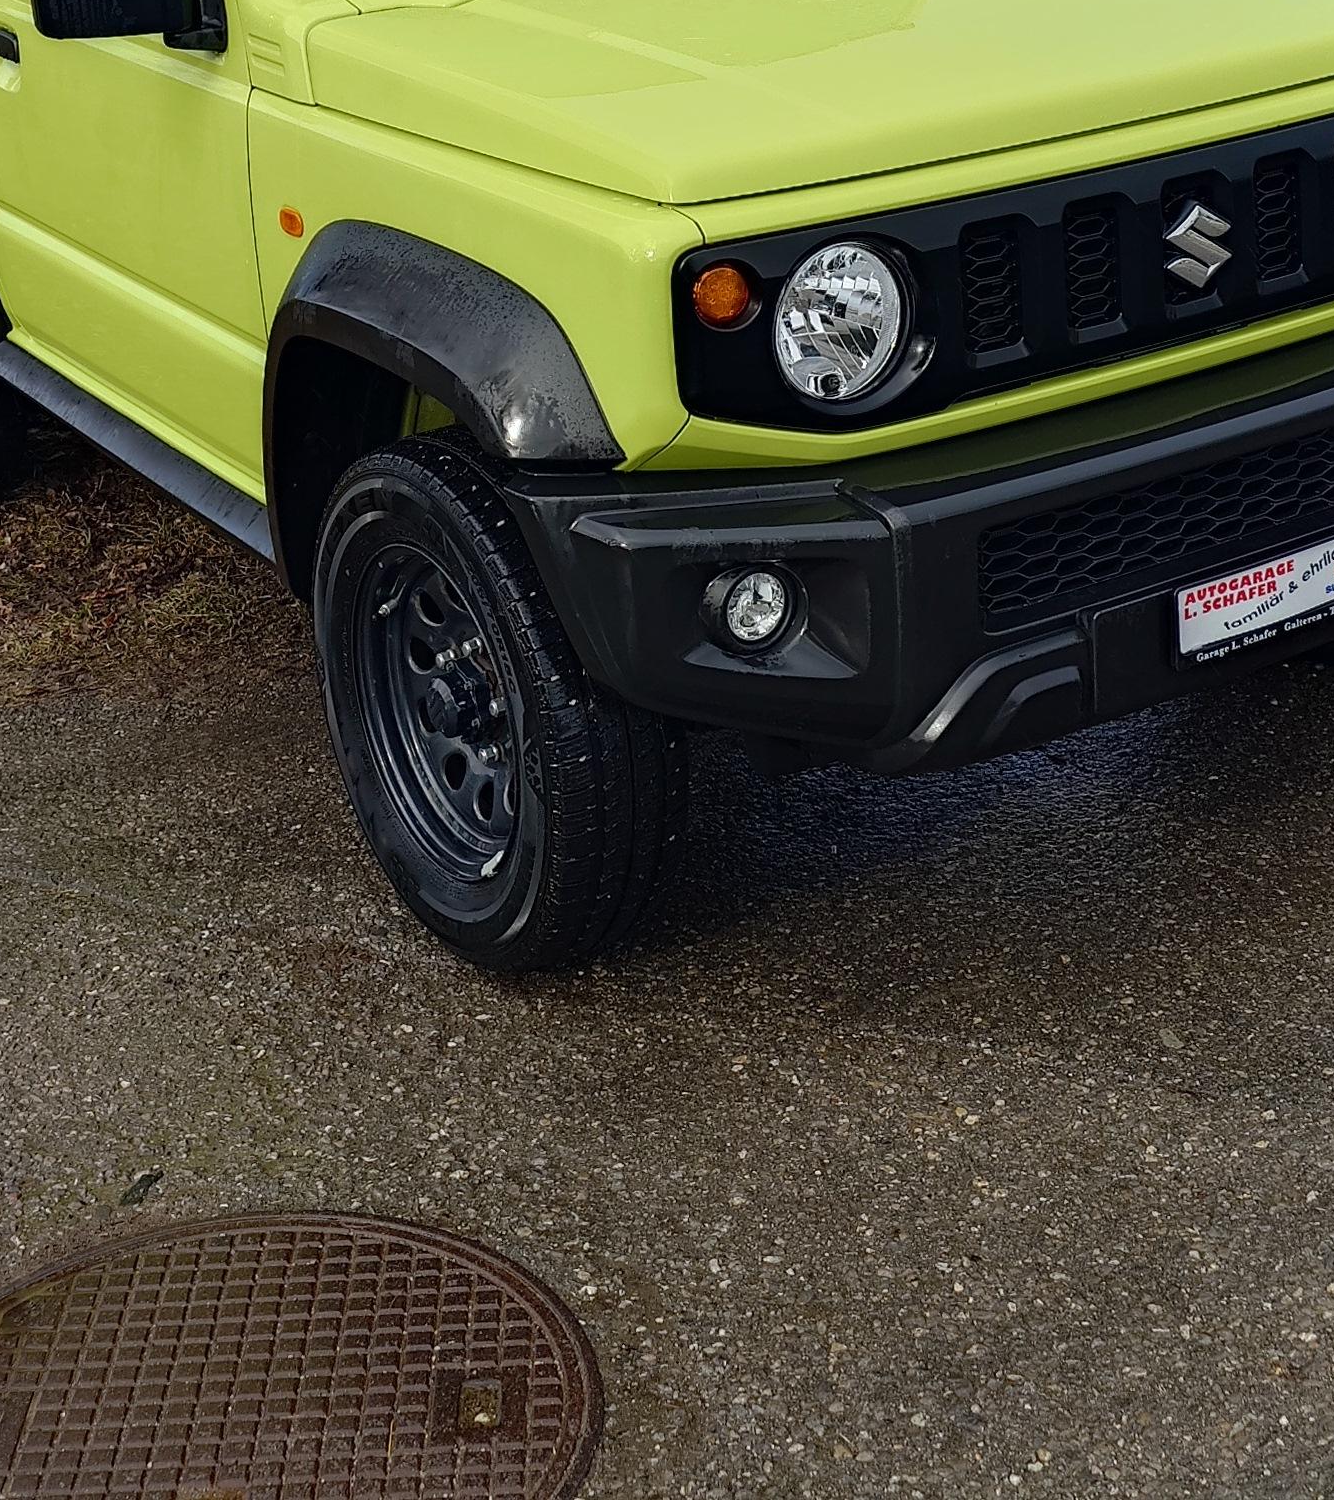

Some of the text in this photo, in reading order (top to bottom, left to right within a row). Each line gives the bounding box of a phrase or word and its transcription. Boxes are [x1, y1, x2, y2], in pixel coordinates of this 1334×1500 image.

[1183, 580, 1277, 620] L. SCHAFER
[1184, 559, 1295, 606] AUTOGARAGE
[1223, 591, 1285, 631] familiär
[1288, 580, 1299, 594] &
[1196, 644, 1230, 662] Garage
[1283, 612, 1323, 632] Galteren
